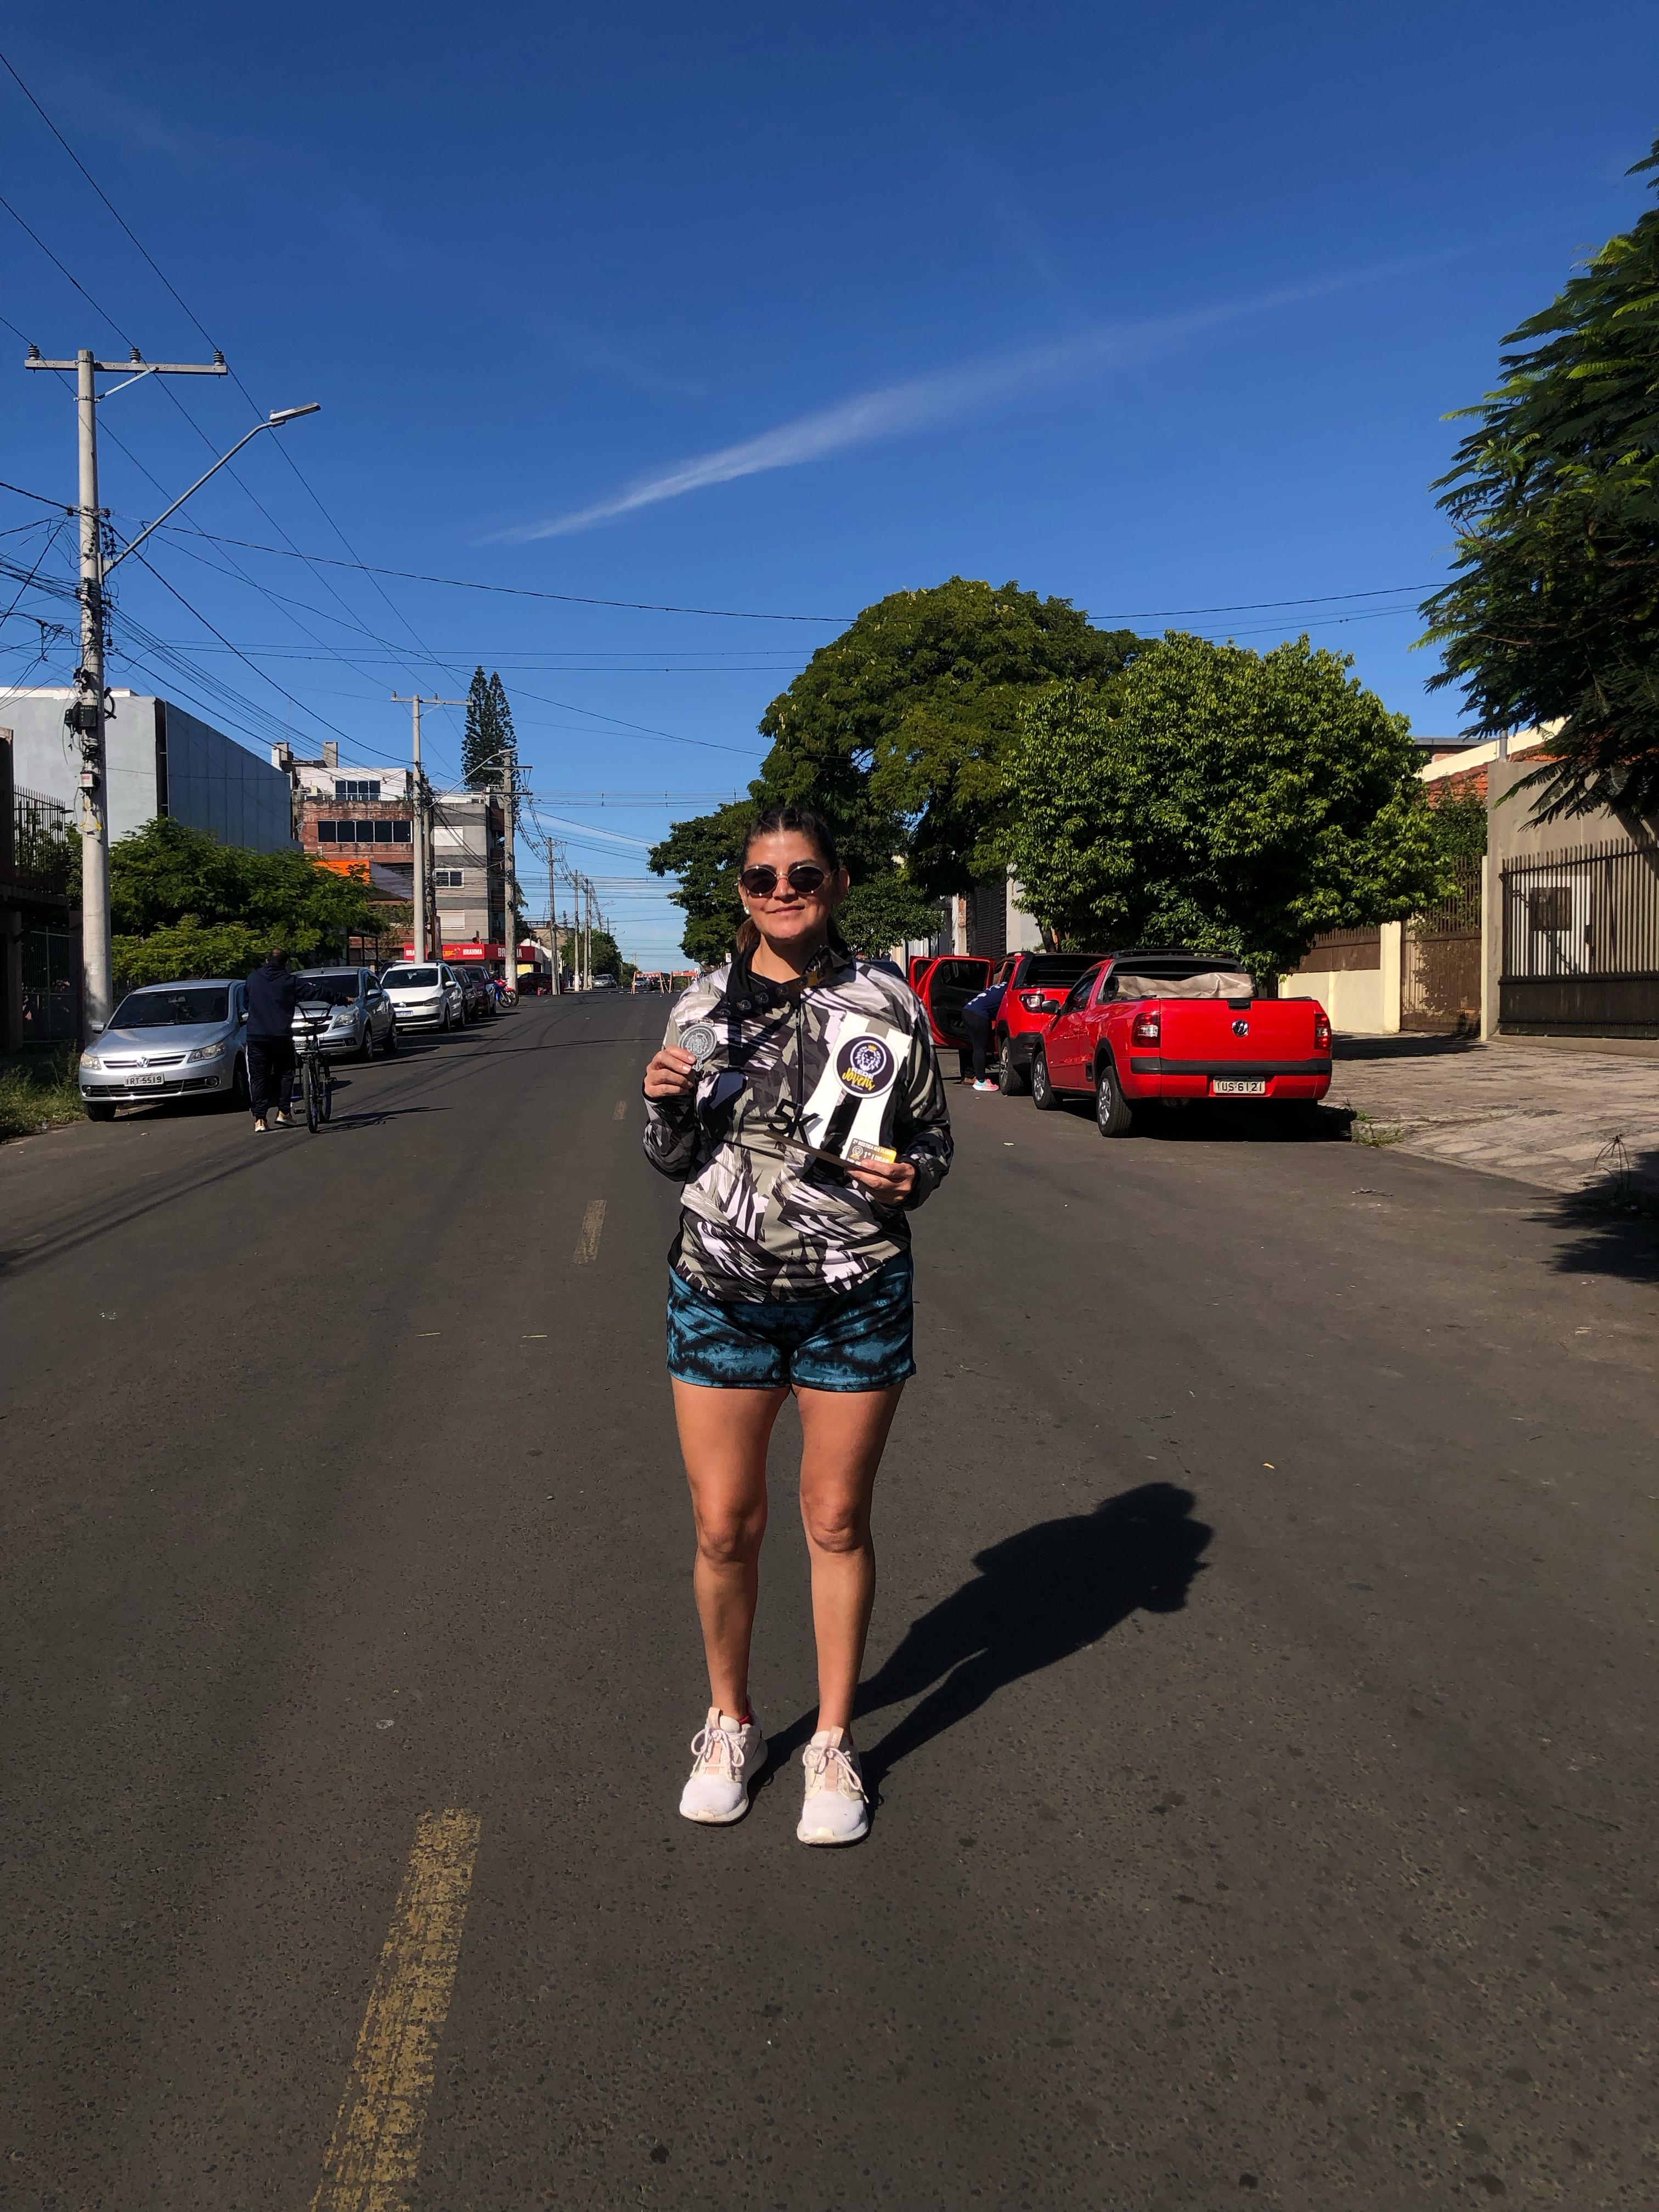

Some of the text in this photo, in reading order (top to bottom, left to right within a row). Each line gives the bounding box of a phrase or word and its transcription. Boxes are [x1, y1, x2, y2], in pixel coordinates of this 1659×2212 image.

[498, 947, 522, 958] BRA
[851, 1066, 874, 1080] REDE
[768, 1098, 820, 1144] 5K
